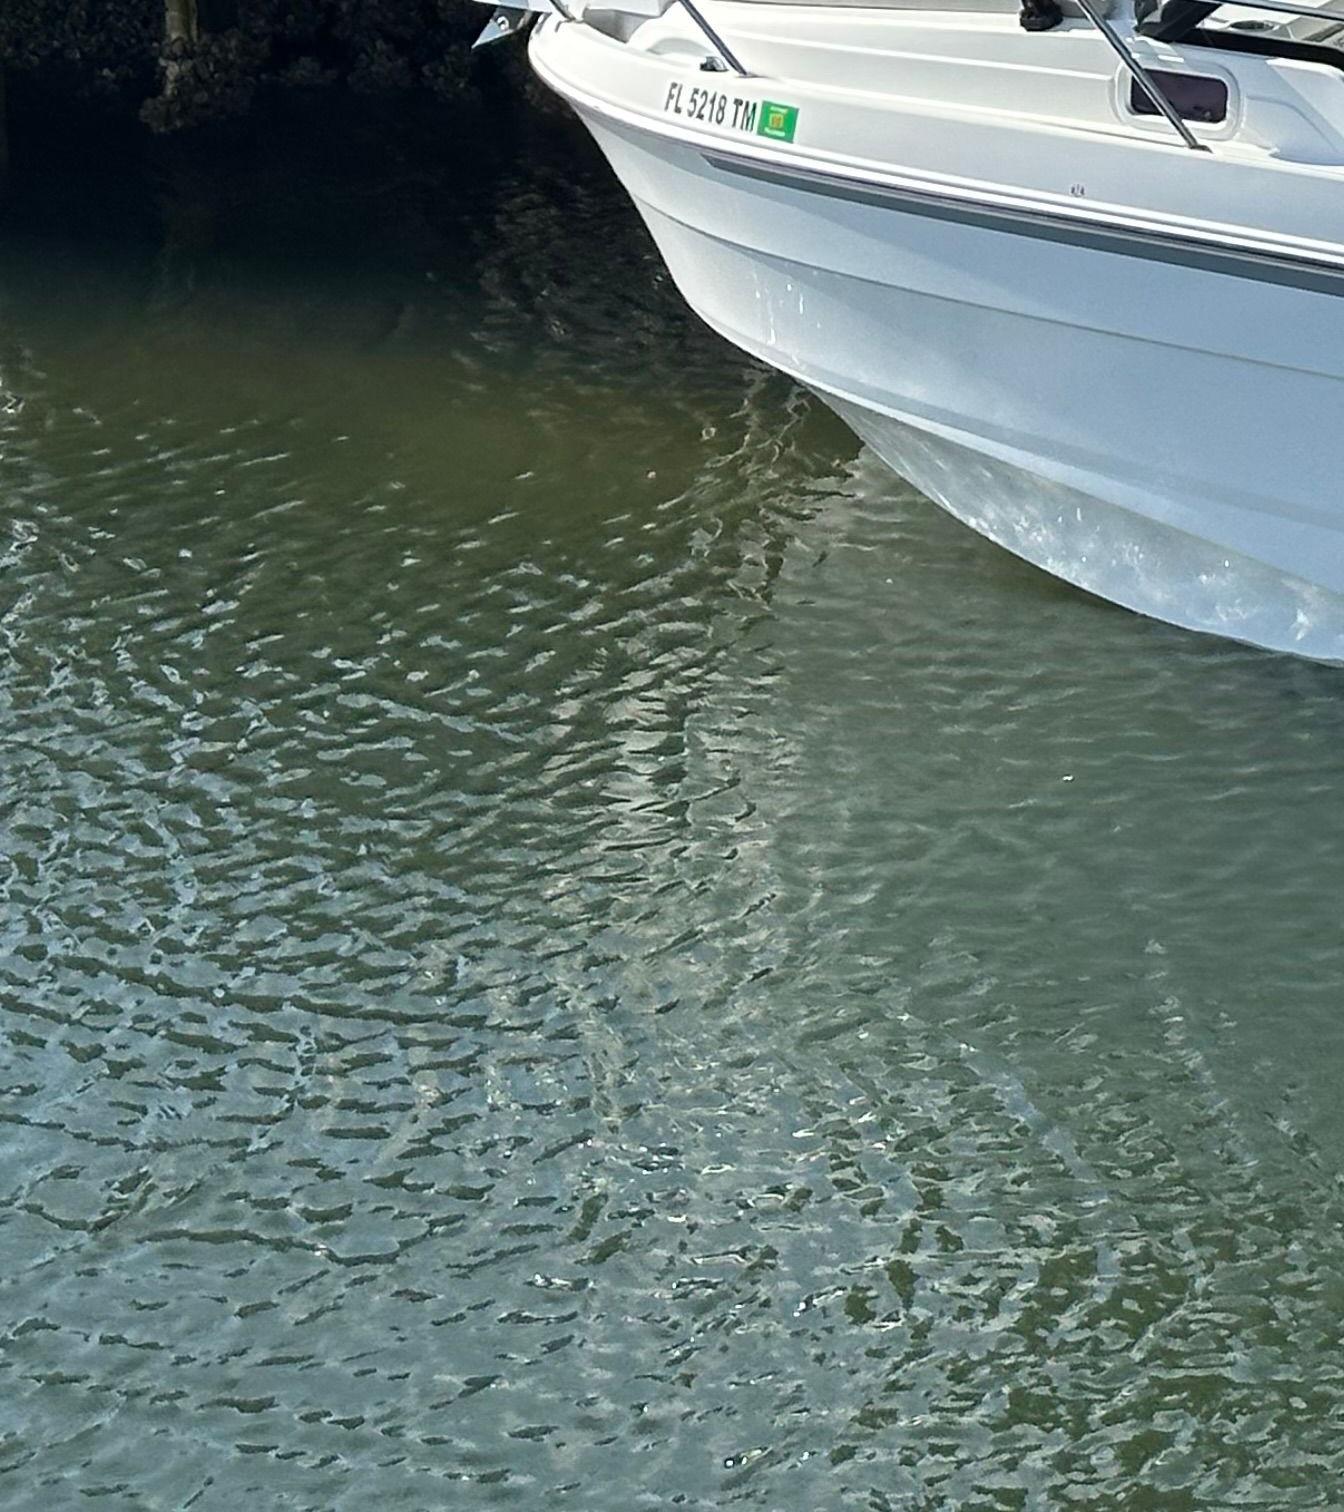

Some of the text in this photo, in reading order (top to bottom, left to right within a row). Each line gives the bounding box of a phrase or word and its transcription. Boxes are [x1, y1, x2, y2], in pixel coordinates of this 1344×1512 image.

[664, 82, 757, 132] FL 5218 TM
